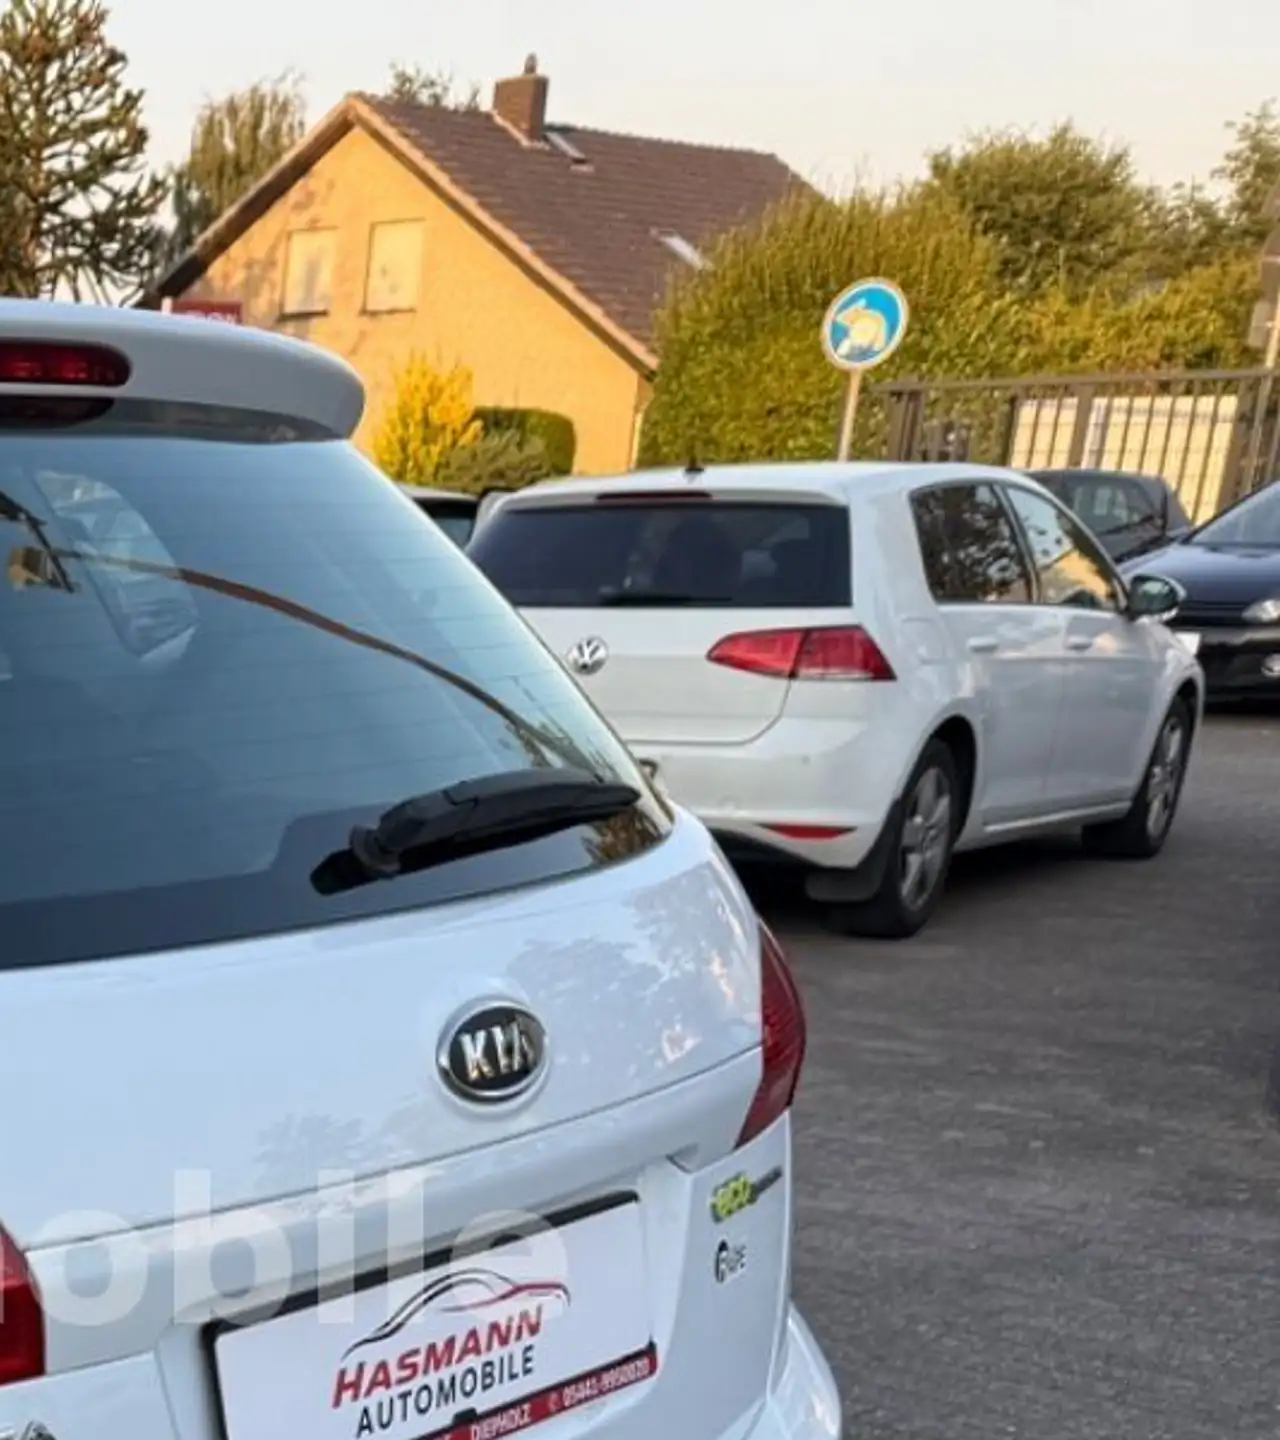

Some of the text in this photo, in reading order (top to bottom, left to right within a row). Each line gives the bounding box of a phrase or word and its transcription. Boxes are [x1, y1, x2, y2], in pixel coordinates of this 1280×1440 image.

[460, 1021, 537, 1080] KIA
[332, 1304, 543, 1408] HASMANN
[356, 1345, 535, 1439] AUTOMOBILE
